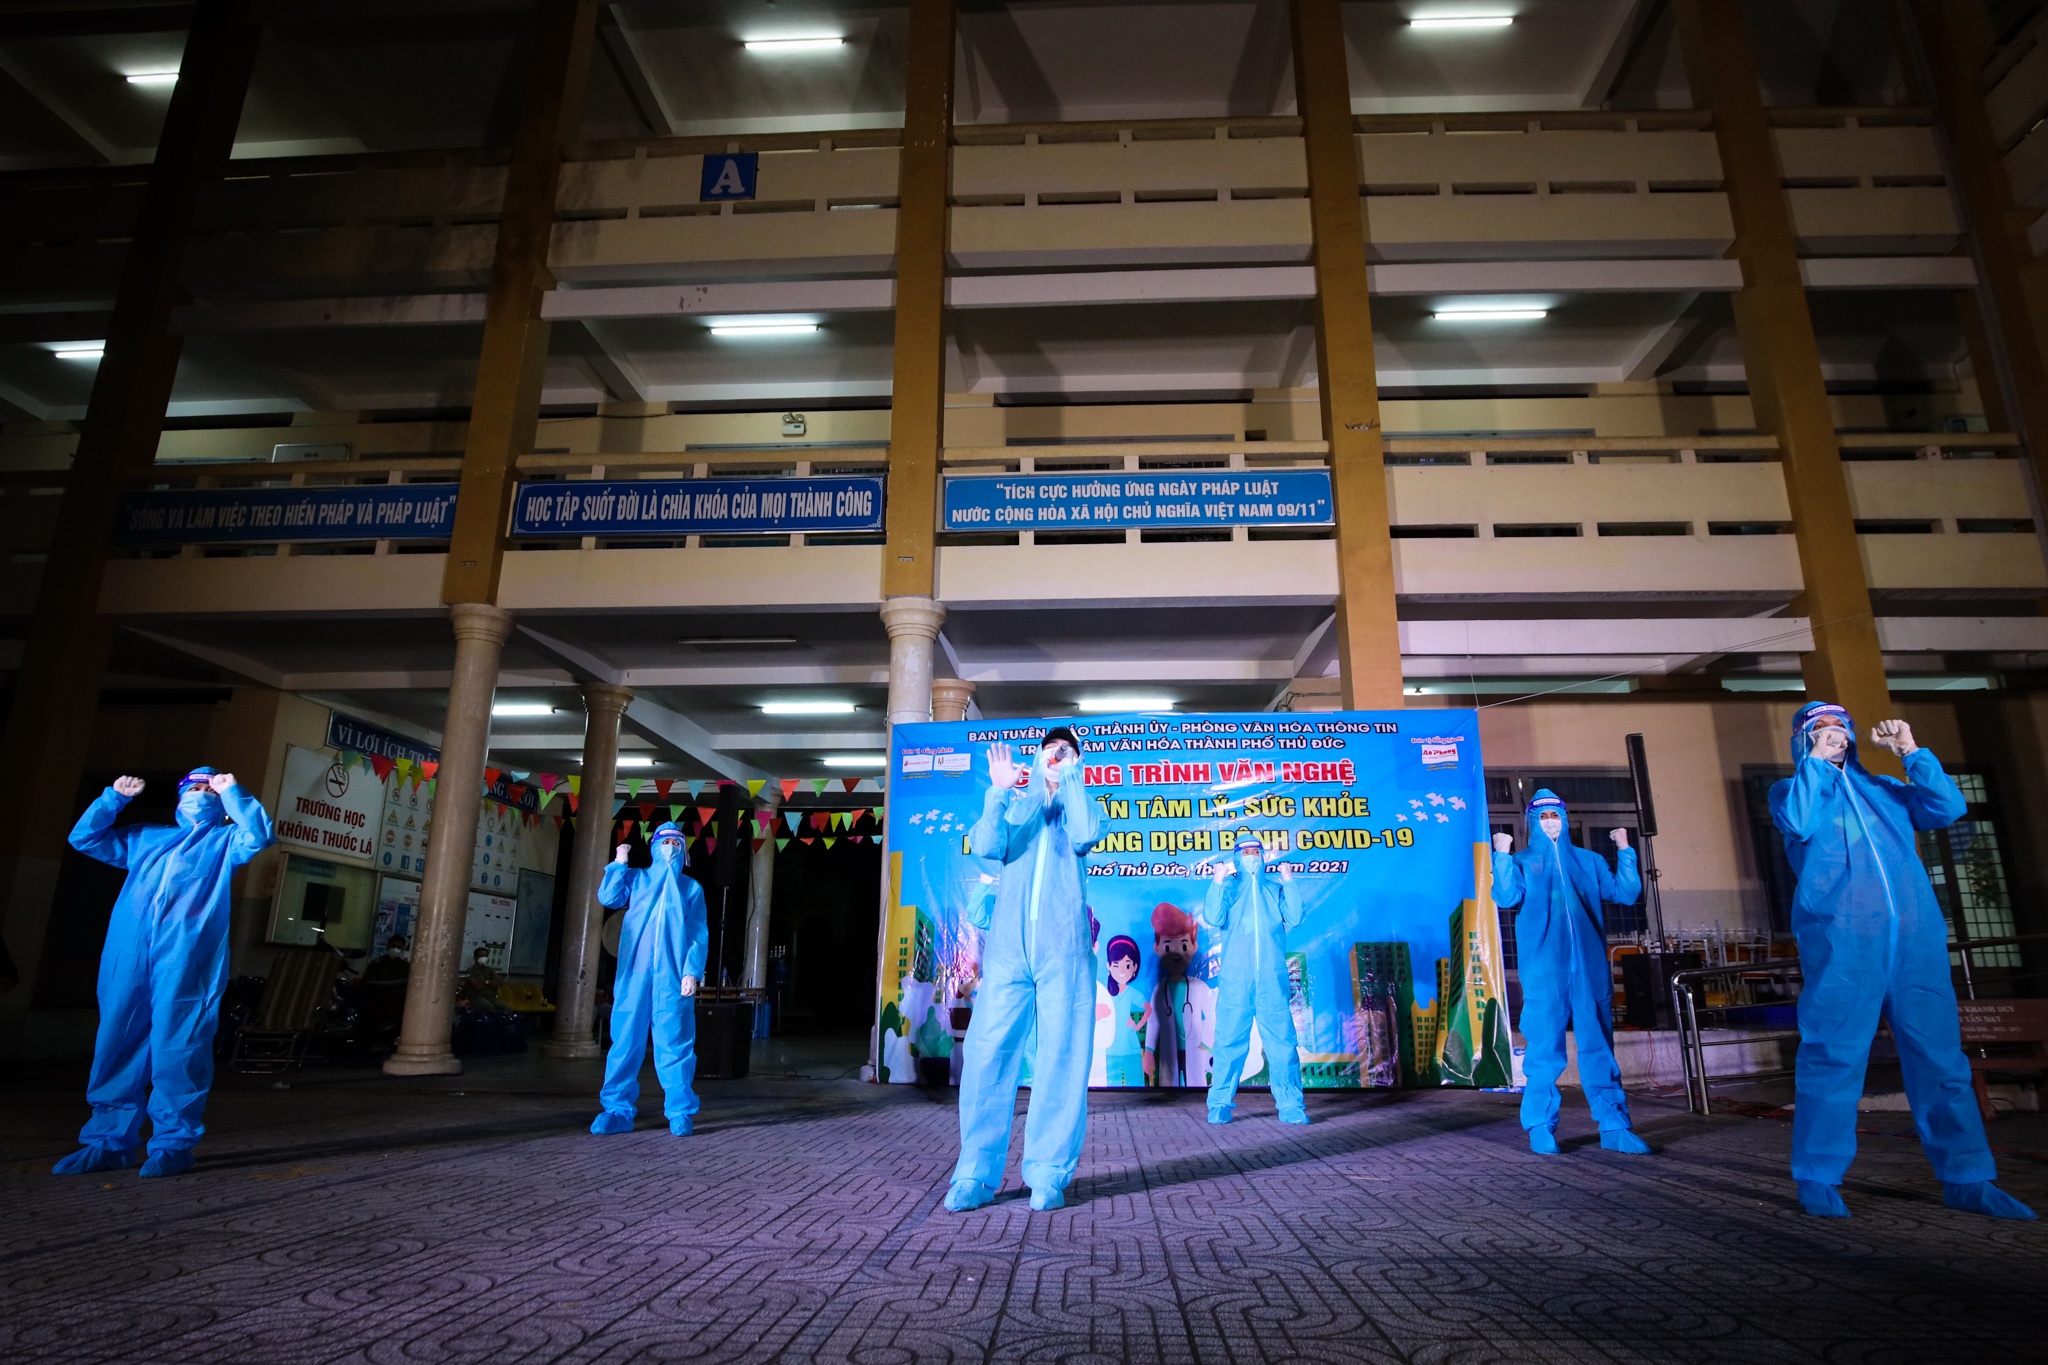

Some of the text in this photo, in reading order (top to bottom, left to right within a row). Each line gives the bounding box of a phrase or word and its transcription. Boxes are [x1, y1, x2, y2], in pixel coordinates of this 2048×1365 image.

[710, 158, 746, 194] A
[1039, 485, 1068, 502] CỰC
[1072, 480, 1121, 499] HƯỞNG
[1125, 481, 1155, 497] ỨNG
[1159, 480, 1198, 497] NGÀY
[1202, 480, 1241, 496] PHÁP
[1244, 479, 1280, 499] LUẬT
[168, 504, 185, 529] VÀ
[186, 503, 214, 529] LÀM
[218, 502, 248, 533] VIỆC
[250, 504, 282, 527] THEO
[284, 497, 316, 527] HIẾN
[318, 498, 353, 526] PHÁP
[356, 498, 374, 525] VÀ
[376, 497, 413, 525] PHÁP
[525, 486, 872, 529] HỌC TẬP SUỐT ĐỜI LÀ CHÌA KHÓA CỦA MỌI THÀNH CÔNG
[952, 507, 991, 523] NƯỚC
[995, 506, 1034, 525] CỘNG
[1038, 504, 1067, 521] HÒA
[1071, 504, 1090, 520] XÃ
[1094, 503, 1119, 523] HỘI
[1122, 500, 1151, 519] CHỦ
[1156, 502, 1201, 519] NGHĨA
[1204, 502, 1235, 521] VIỆT
[1239, 504, 1273, 518] NAM
[338, 723, 355, 746] VÌ
[356, 731, 380, 756] LỢI
[383, 736, 407, 761] ÍCH
[968, 731, 999, 742] BAN
[1002, 726, 1046, 741] TUYÊN
[1093, 722, 1145, 736] THÀNH
[1149, 720, 1169, 734] ỦY
[1180, 720, 1238, 734] PHÒNG
[1241, 721, 1275, 734] VĂN
[1278, 721, 1314, 734] HÓA
[1317, 721, 1371, 734] THÔNG
[1374, 722, 1399, 734] TIN
[1109, 738, 1143, 751] VĂN
[1146, 737, 1181, 750] HÓA
[1185, 737, 1238, 750] THÀNH
[1241, 735, 1275, 750] PHỐ
[1277, 736, 1307, 750] THỦ
[1311, 737, 1346, 750] ĐỨC
[1128, 759, 1211, 785] TRÌNH
[1217, 758, 1276, 784] VĂN
[1281, 758, 1357, 787] NGHỆ
[296, 796, 366, 829] TRƯỜNG HỌC
[1135, 794, 1192, 819] TÂM
[1198, 794, 1237, 820] LÝ,
[1243, 793, 1296, 818] SỨC
[1303, 791, 1371, 818] KHỎE
[278, 820, 372, 855] KHÔNG THUỐC LÁ
[1150, 830, 1212, 856] DỊCH
[1296, 827, 1415, 852] COVID-19
[1118, 862, 1148, 877] Thủ
[1151, 861, 1191, 878] Đức,
[1265, 861, 1305, 874] nm
[1308, 860, 1349, 874] 2021
